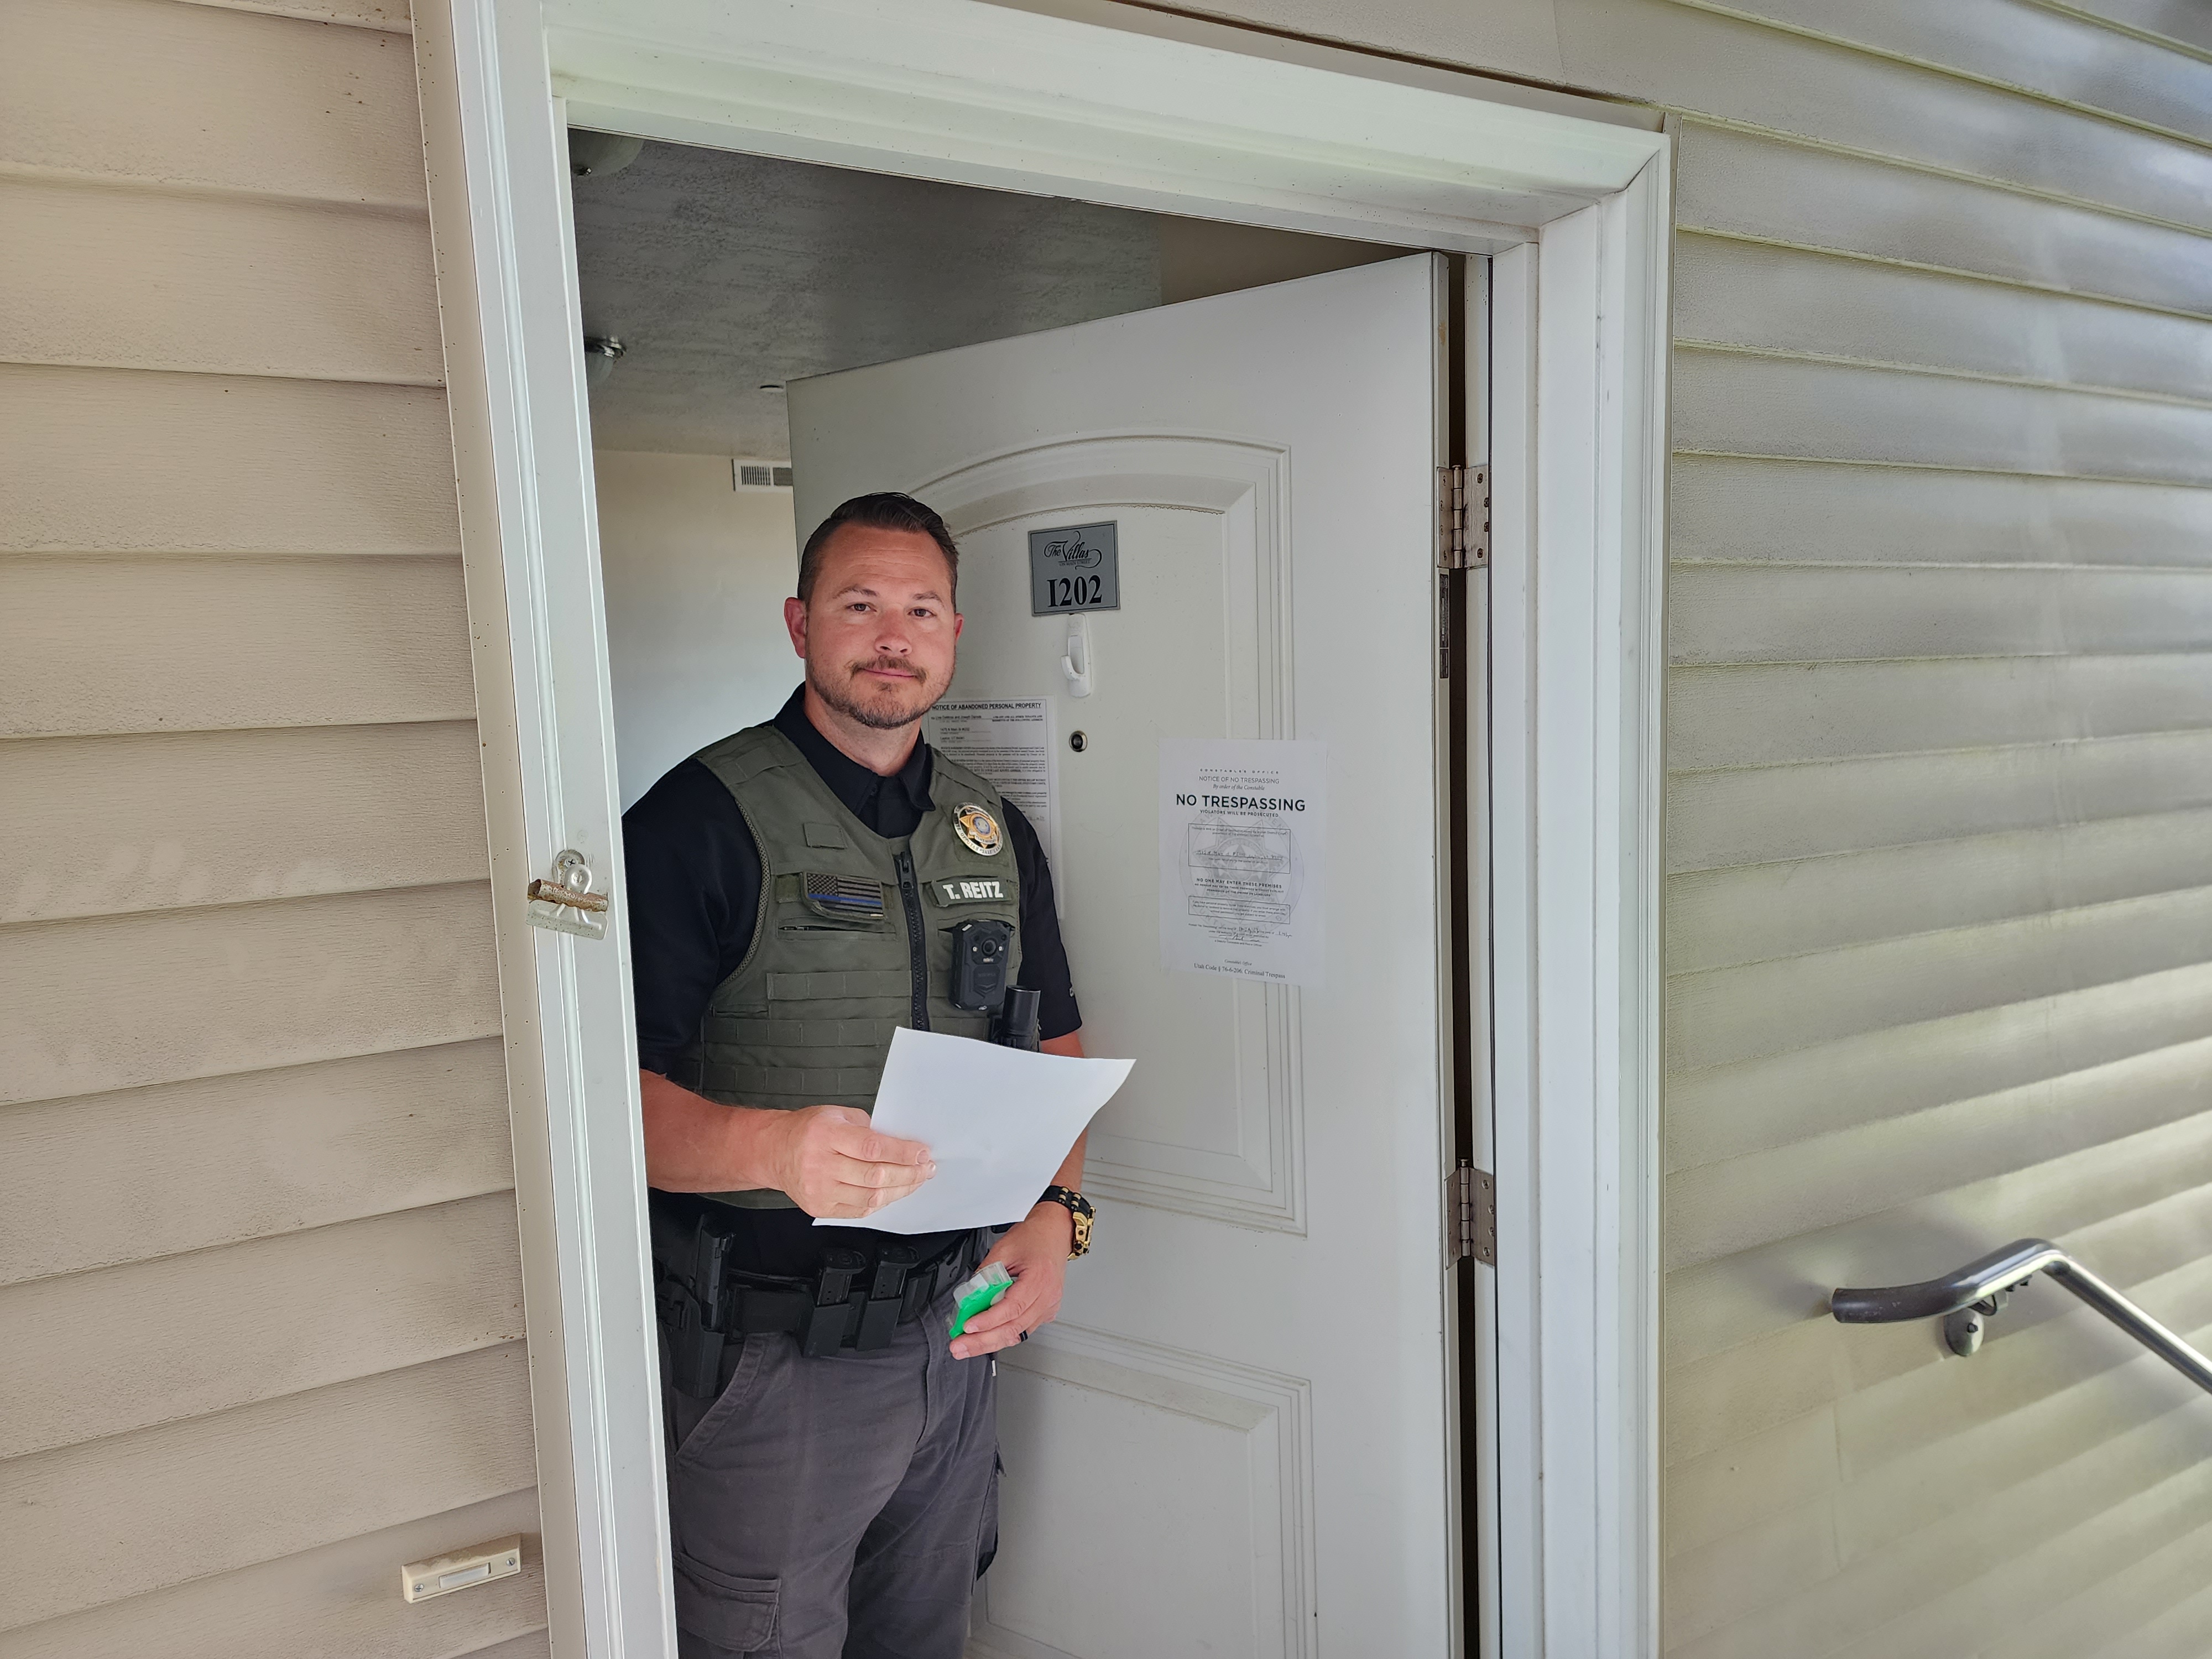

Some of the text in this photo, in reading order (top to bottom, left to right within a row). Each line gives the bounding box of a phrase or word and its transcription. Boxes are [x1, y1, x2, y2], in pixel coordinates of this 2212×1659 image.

[1044, 541, 1061, 557] The
[1176, 794, 1305, 811] NO TRESPASSING
[943, 881, 1004, 900] T. REITZ
